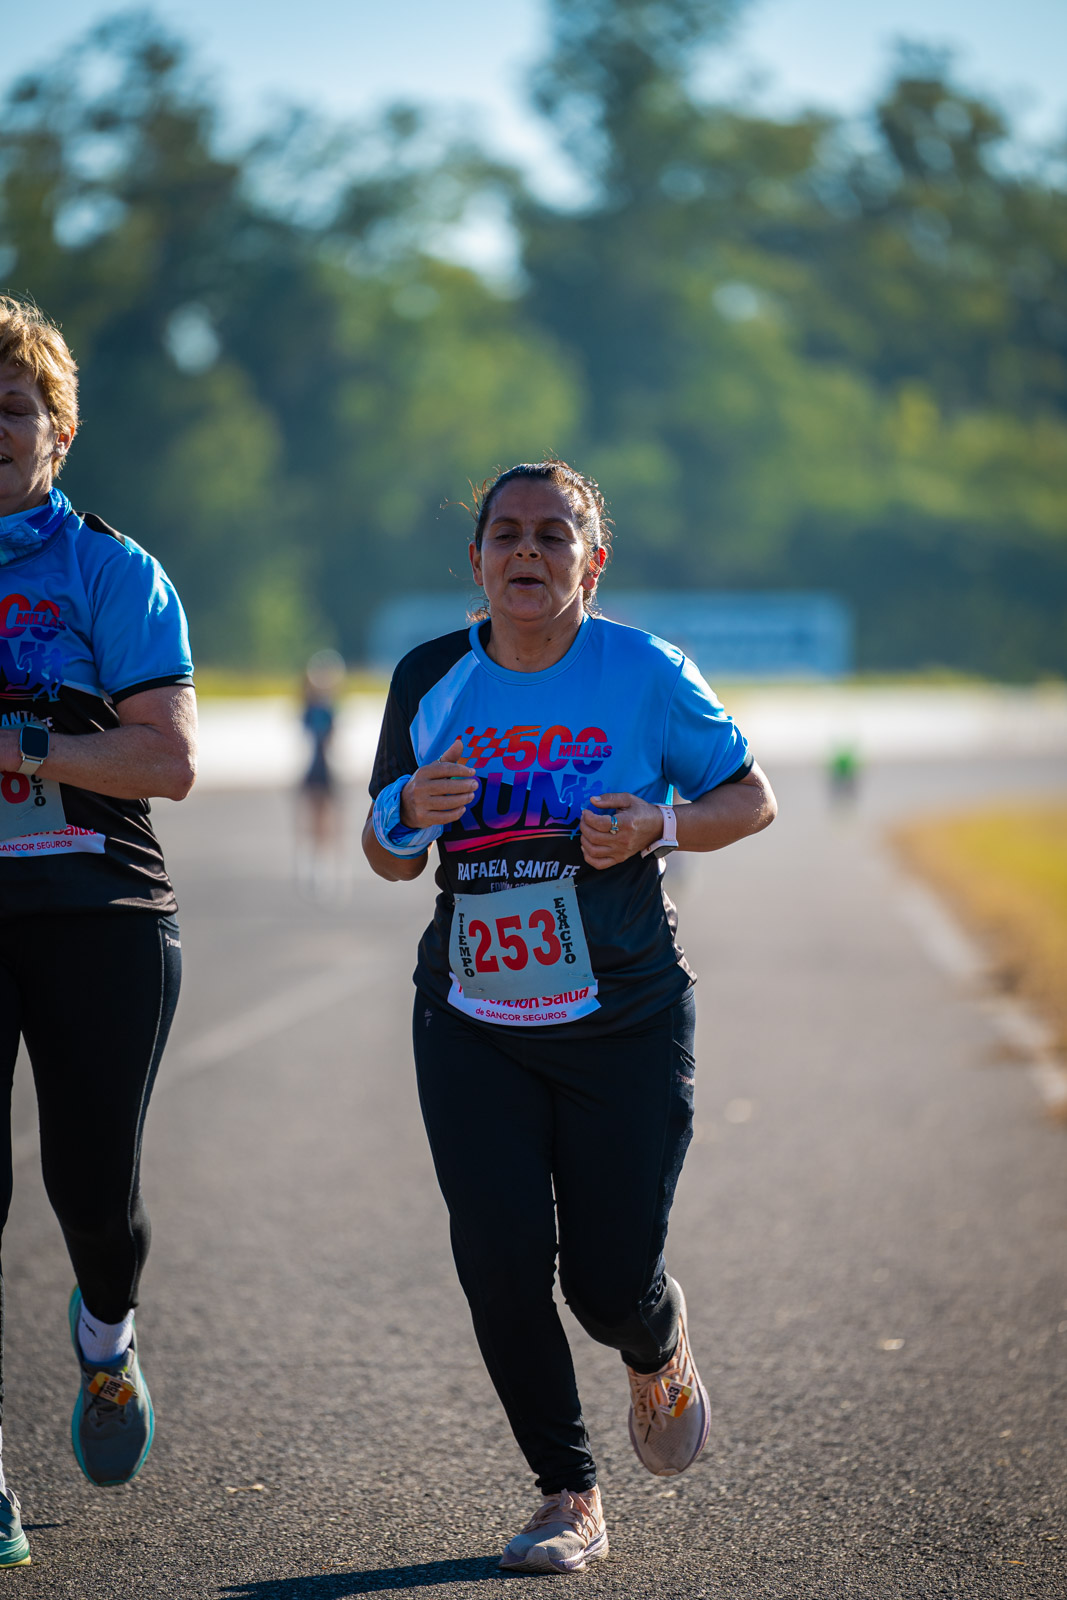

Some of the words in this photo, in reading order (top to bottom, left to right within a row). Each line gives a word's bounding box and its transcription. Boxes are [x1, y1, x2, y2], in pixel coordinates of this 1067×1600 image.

[15, 612, 67, 631] MILLAS
[502, 725, 608, 775] 500
[558, 744, 613, 759] MILLAS
[36, 840, 73, 850] SEGUROS
[457, 859, 509, 881] RAFAELA,
[513, 859, 560, 879] SANTA
[559, 864, 581, 880] FE
[468, 909, 562, 973] 253
[553, 897, 577, 965] EXACTO
[458, 913, 475, 978] TIEMPO
[475, 1006, 485, 1016] de
[485, 1010, 521, 1022] SANCOR
[522, 1010, 568, 1022] SEGUROS
